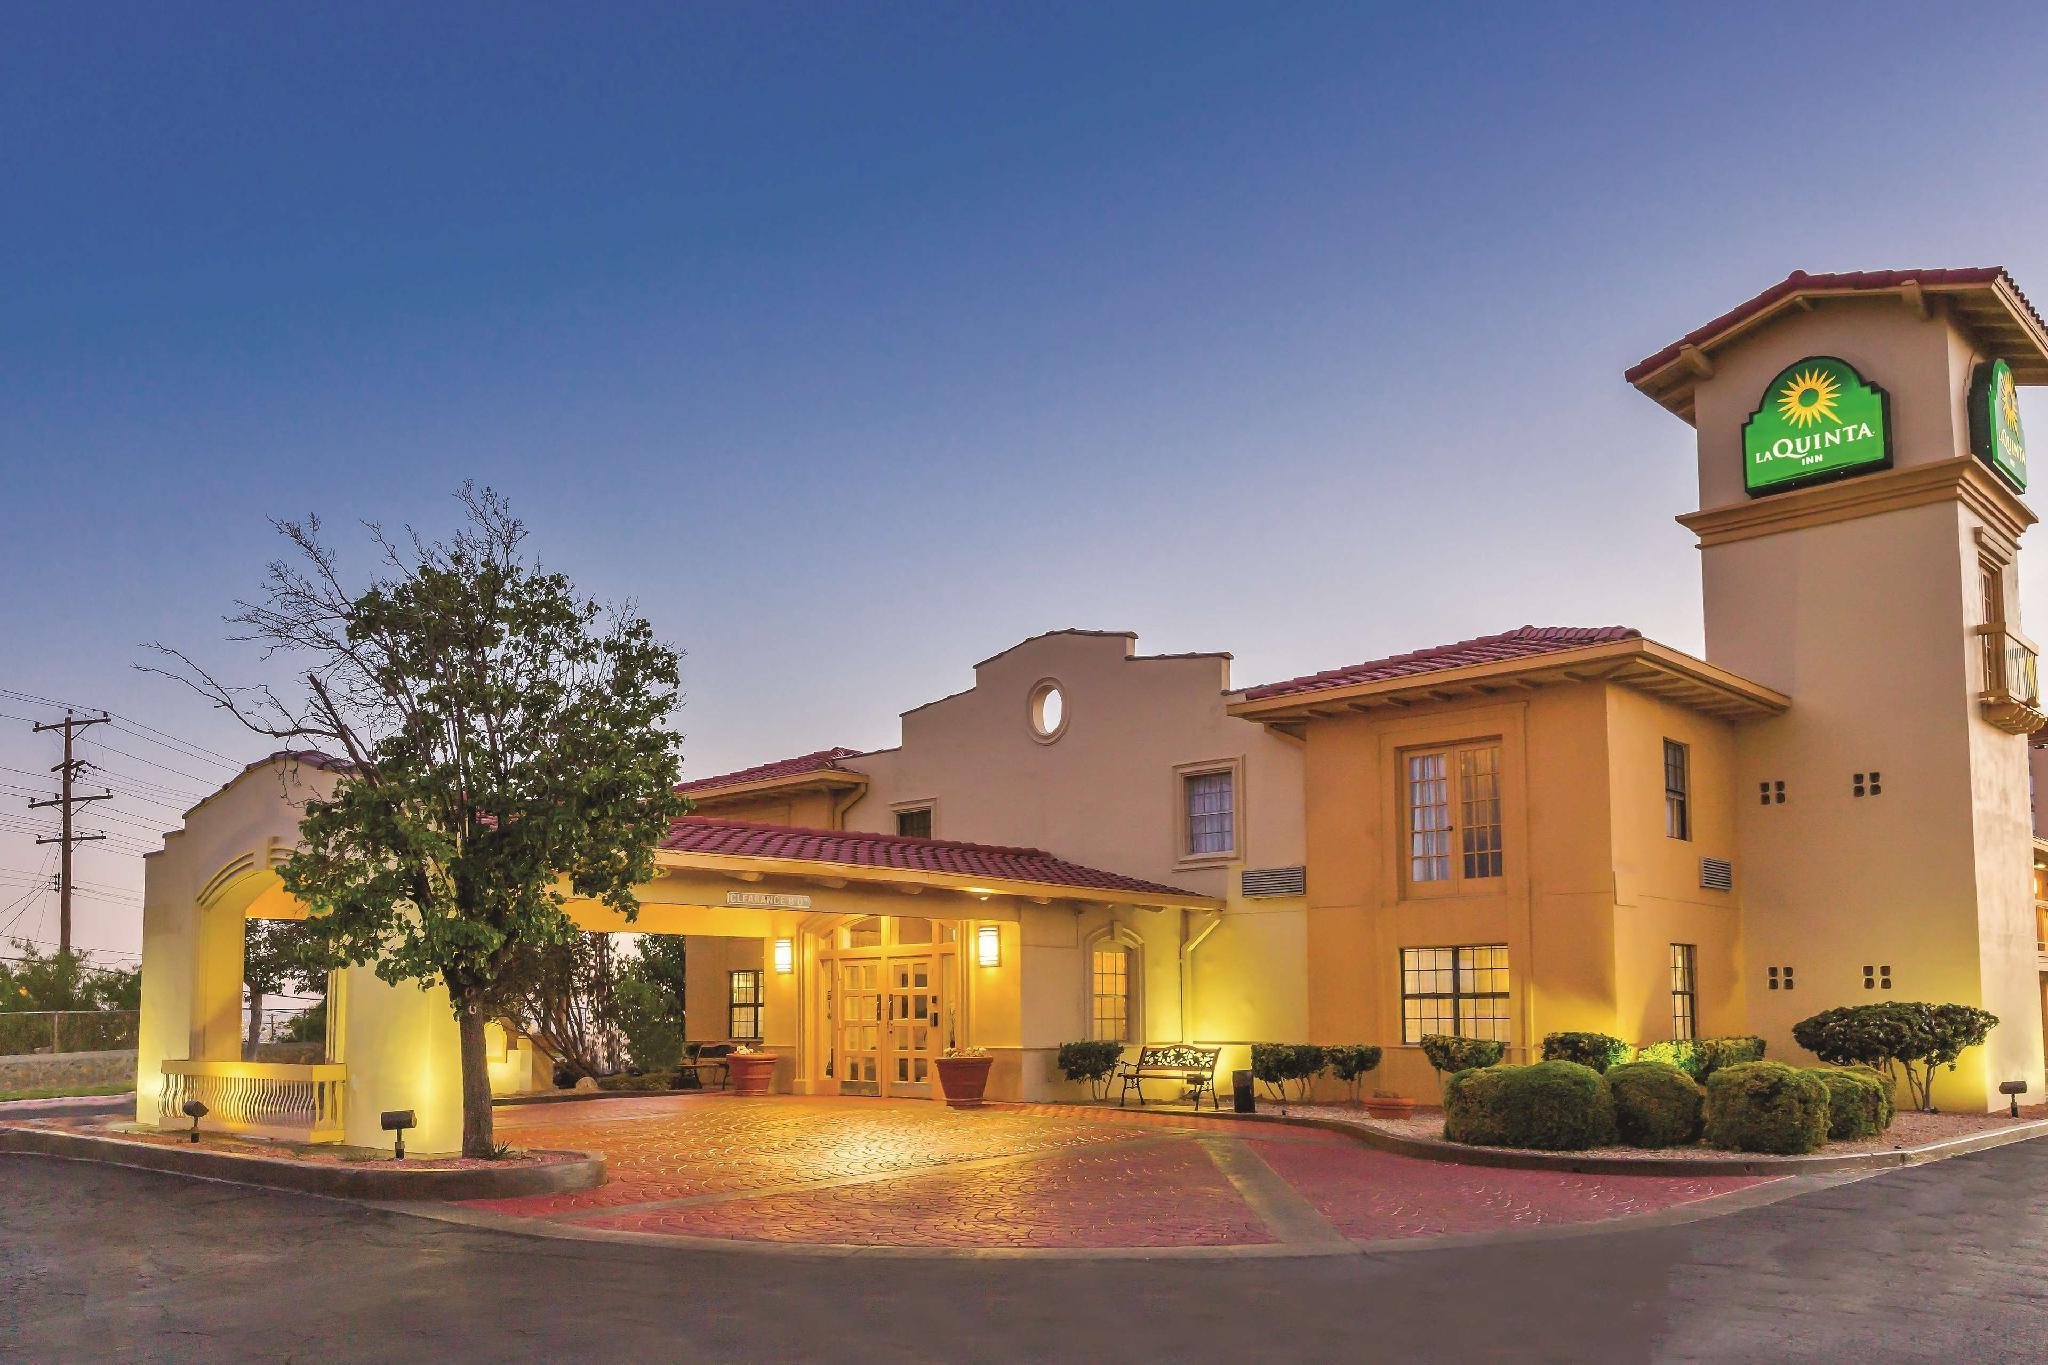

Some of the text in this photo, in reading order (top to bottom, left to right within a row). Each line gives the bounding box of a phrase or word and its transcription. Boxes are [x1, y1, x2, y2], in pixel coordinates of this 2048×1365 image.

[1755, 422, 1875, 463] LA QUINTA
[1801, 454, 1823, 466] INN
[730, 893, 785, 905] CLEARANCE
